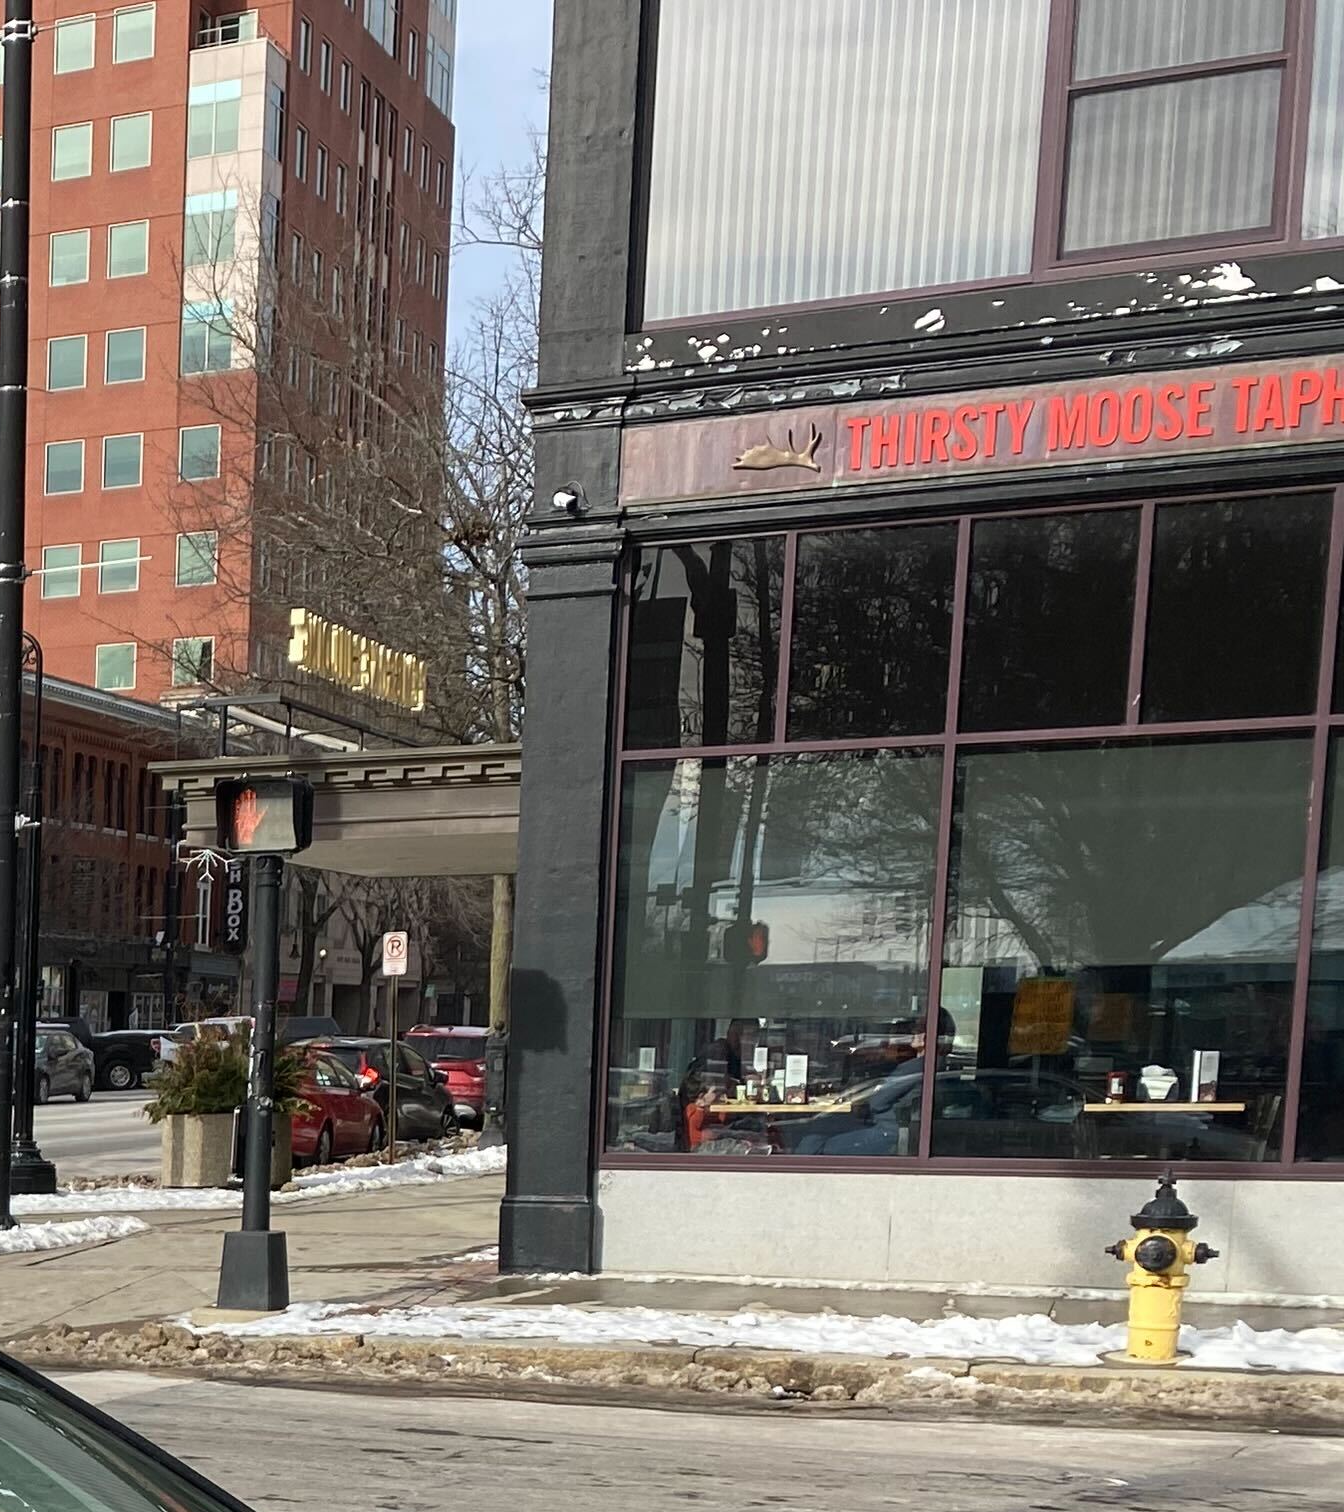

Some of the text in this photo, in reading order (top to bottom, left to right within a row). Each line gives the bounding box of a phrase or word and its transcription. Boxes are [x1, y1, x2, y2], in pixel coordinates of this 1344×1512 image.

[846, 367, 1344, 471] THIRSTY MOOSE TAPH
